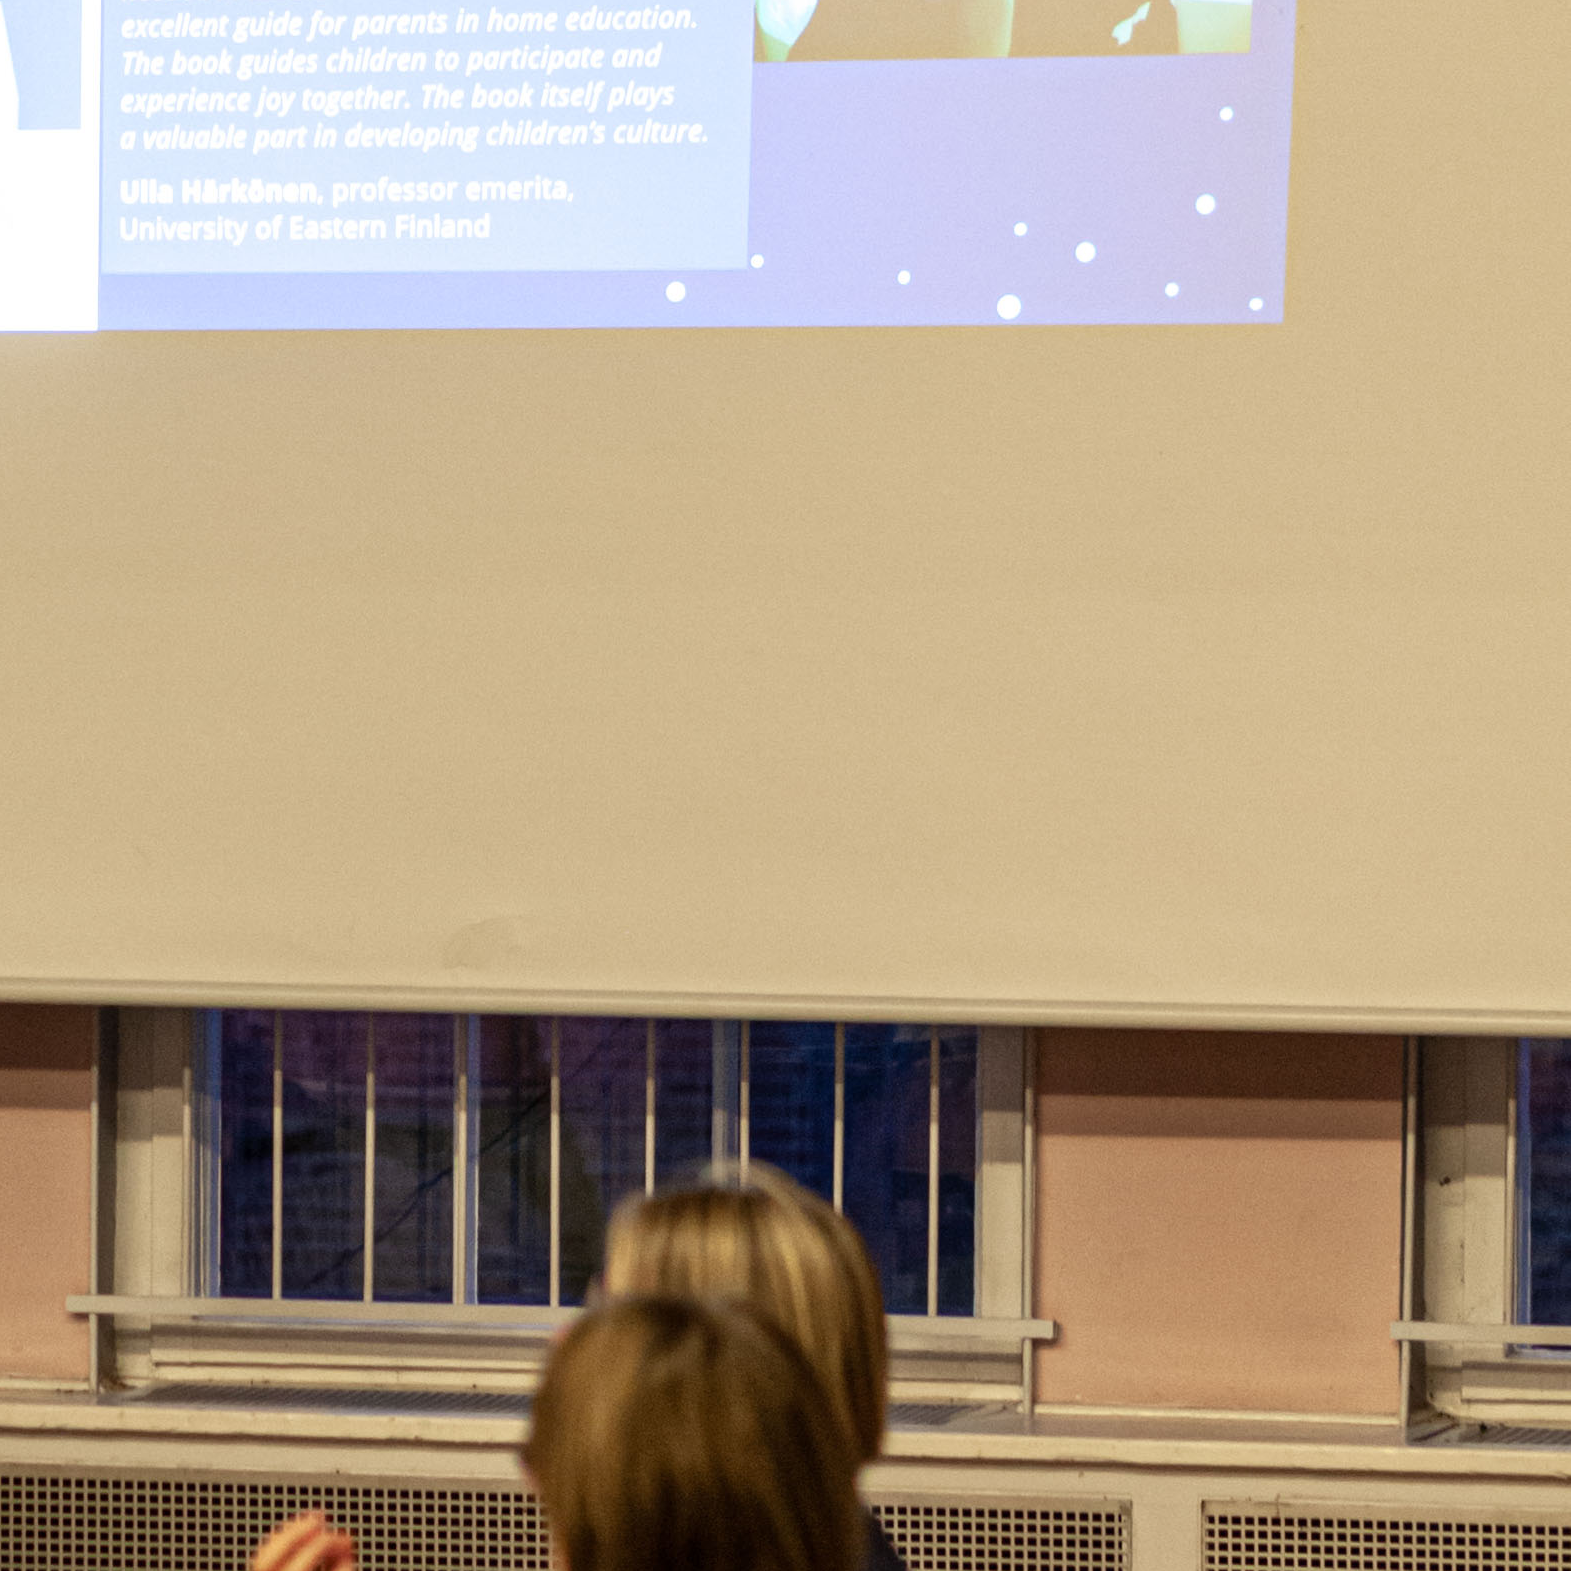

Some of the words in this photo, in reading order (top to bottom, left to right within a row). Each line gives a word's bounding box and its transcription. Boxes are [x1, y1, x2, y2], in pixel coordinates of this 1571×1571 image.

[122, 50, 165, 75] The
[170, 48, 232, 75] book
[236, 47, 318, 80] guides
[325, 45, 427, 73] children
[434, 48, 460, 71] to
[464, 43, 605, 76] participate
[611, 42, 663, 68] and
[119, 130, 136, 150] a
[142, 123, 247, 150] valuable
[252, 125, 308, 154] part
[313, 121, 337, 148] in
[344, 120, 480, 152] developing
[612, 118, 707, 144] culture.
[119, 178, 173, 204] Ulla
[181, 177, 323, 205] Härkönen,
[332, 175, 458, 208] professor
[465, 174, 573, 202] emerita,
[119, 215, 248, 246] University
[255, 214, 283, 240] of
[289, 214, 386, 240] Eastern
[395, 212, 490, 238] Finland
